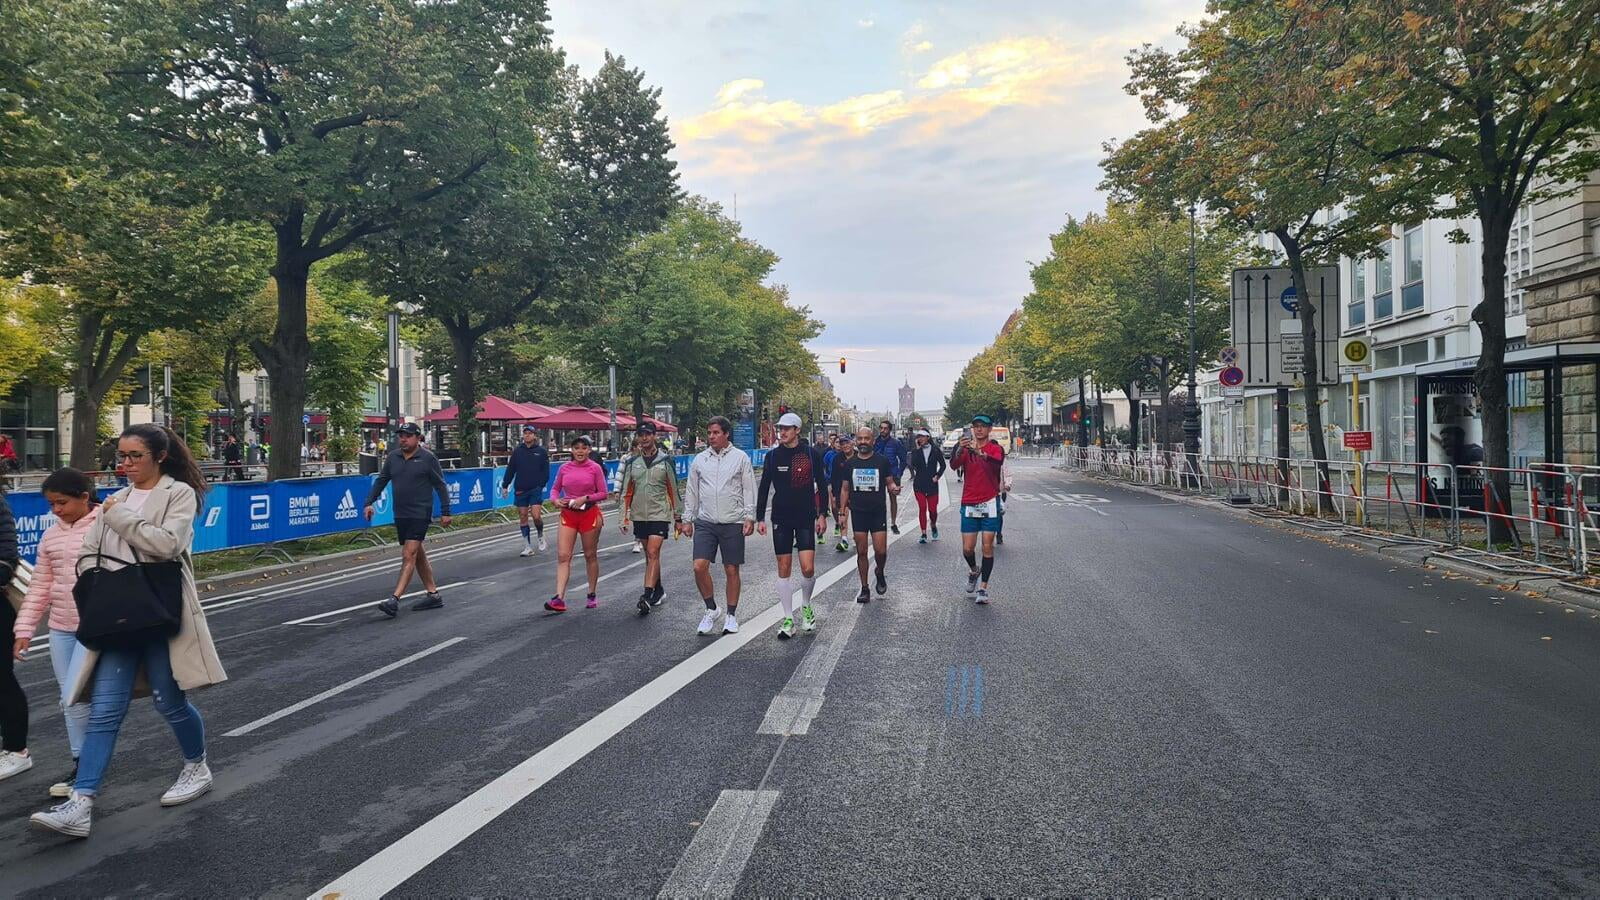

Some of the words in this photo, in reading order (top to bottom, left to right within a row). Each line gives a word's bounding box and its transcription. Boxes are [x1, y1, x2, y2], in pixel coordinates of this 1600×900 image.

[1351, 345, 1362, 357] H
[1427, 382, 1479, 394] IMPOSSIB
[1444, 477, 1483, 490] NTHIN
[289, 496, 309, 509] BMW
[289, 507, 309, 518] BERLIN
[334, 507, 358, 520] adidas
[14, 514, 38, 532] MW
[288, 515, 320, 526] MARATHON
[16, 532, 38, 544] RLIN
